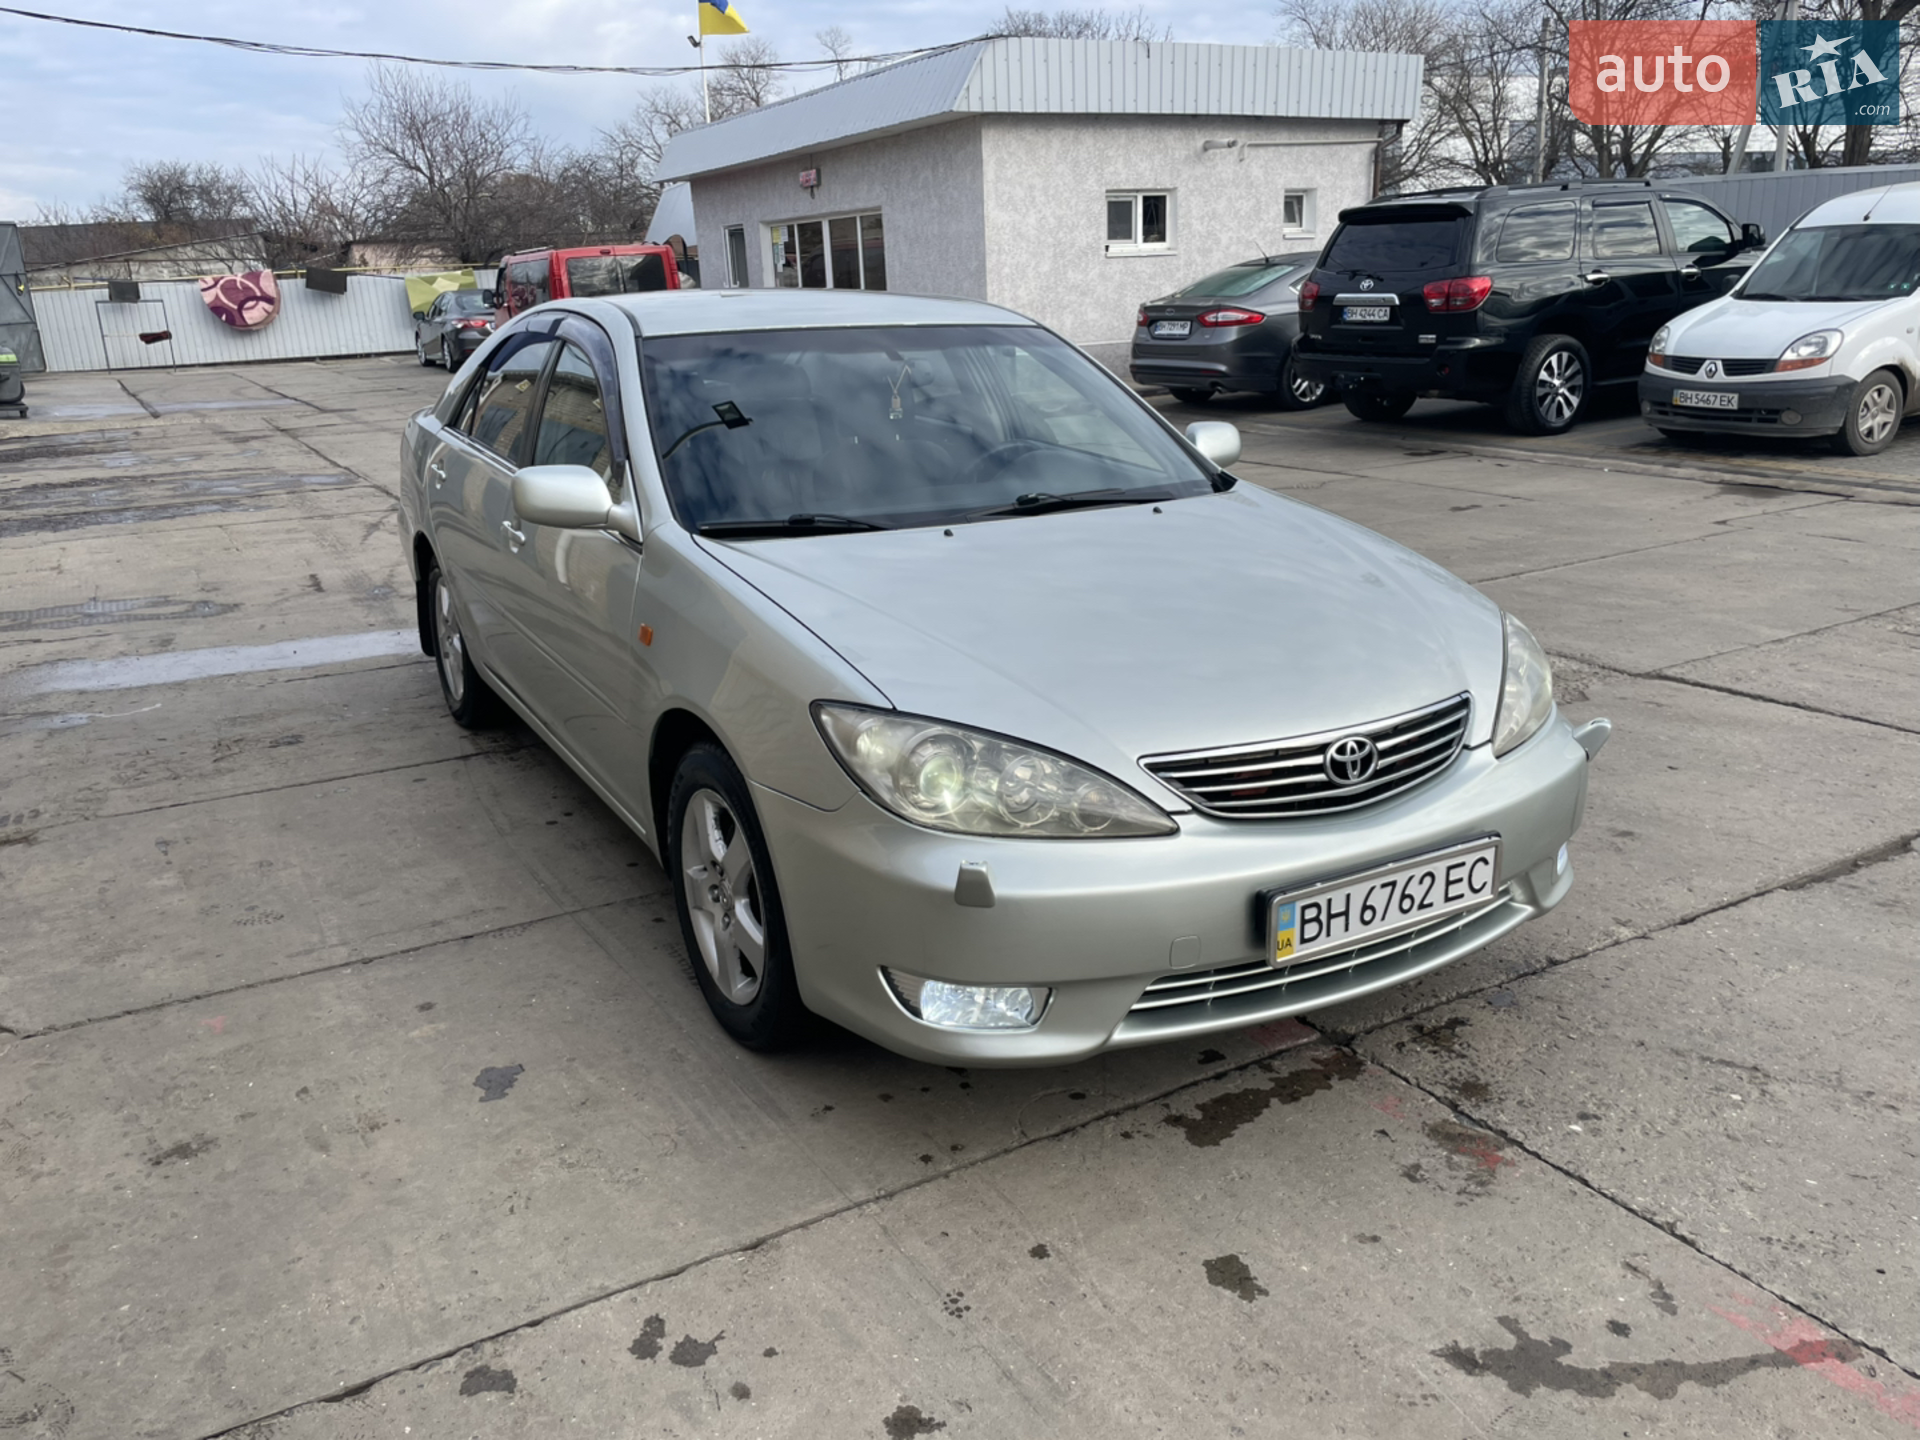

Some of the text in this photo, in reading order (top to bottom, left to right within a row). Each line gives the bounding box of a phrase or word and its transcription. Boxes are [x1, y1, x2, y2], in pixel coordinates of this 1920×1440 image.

[1679, 391, 1736, 408] BH 5467 EK
[1300, 857, 1490, 945] BH 6762 EC
[1276, 937, 1293, 951] UA
